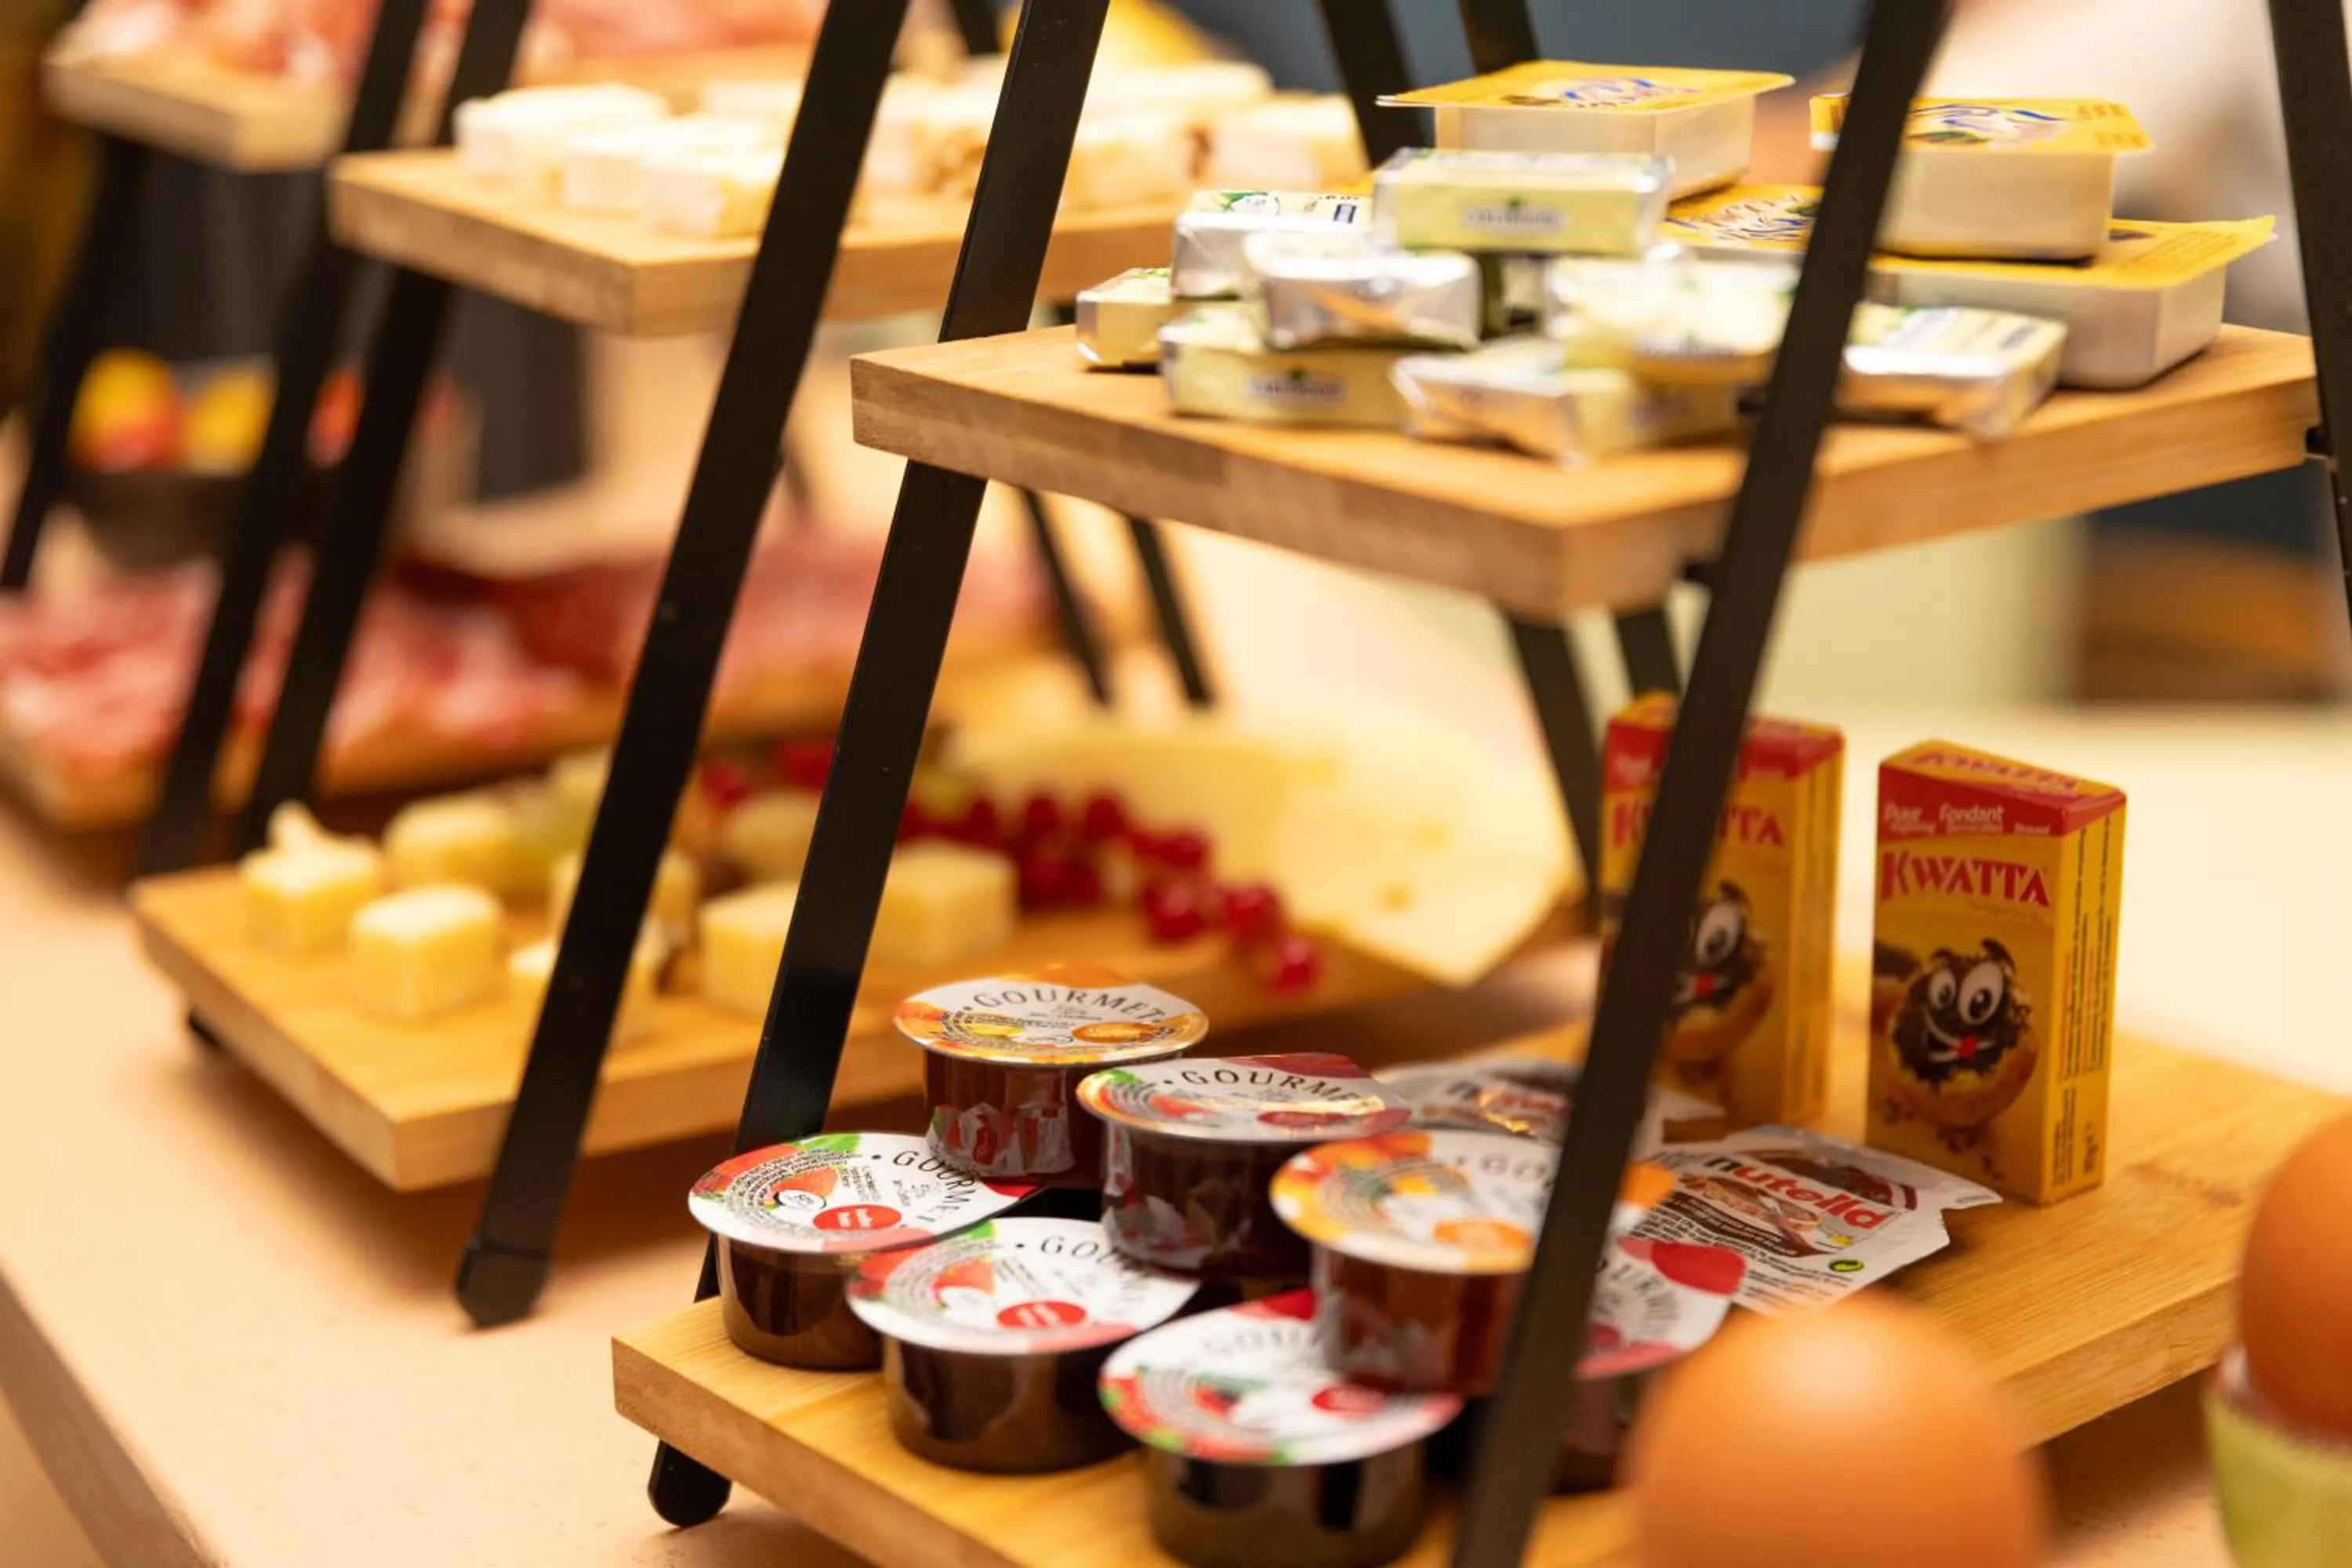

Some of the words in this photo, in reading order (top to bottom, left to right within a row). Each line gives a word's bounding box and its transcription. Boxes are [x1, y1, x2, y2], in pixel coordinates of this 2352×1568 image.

[1613, 802, 1784, 848] KTTA
[1939, 803, 2005, 824] Fondant
[1881, 849, 2051, 909] KWATTA
[973, 988, 1166, 1018] GOURMET
[1181, 1068, 1363, 1102] GOURME
[1703, 1156, 1890, 1230] nutella
